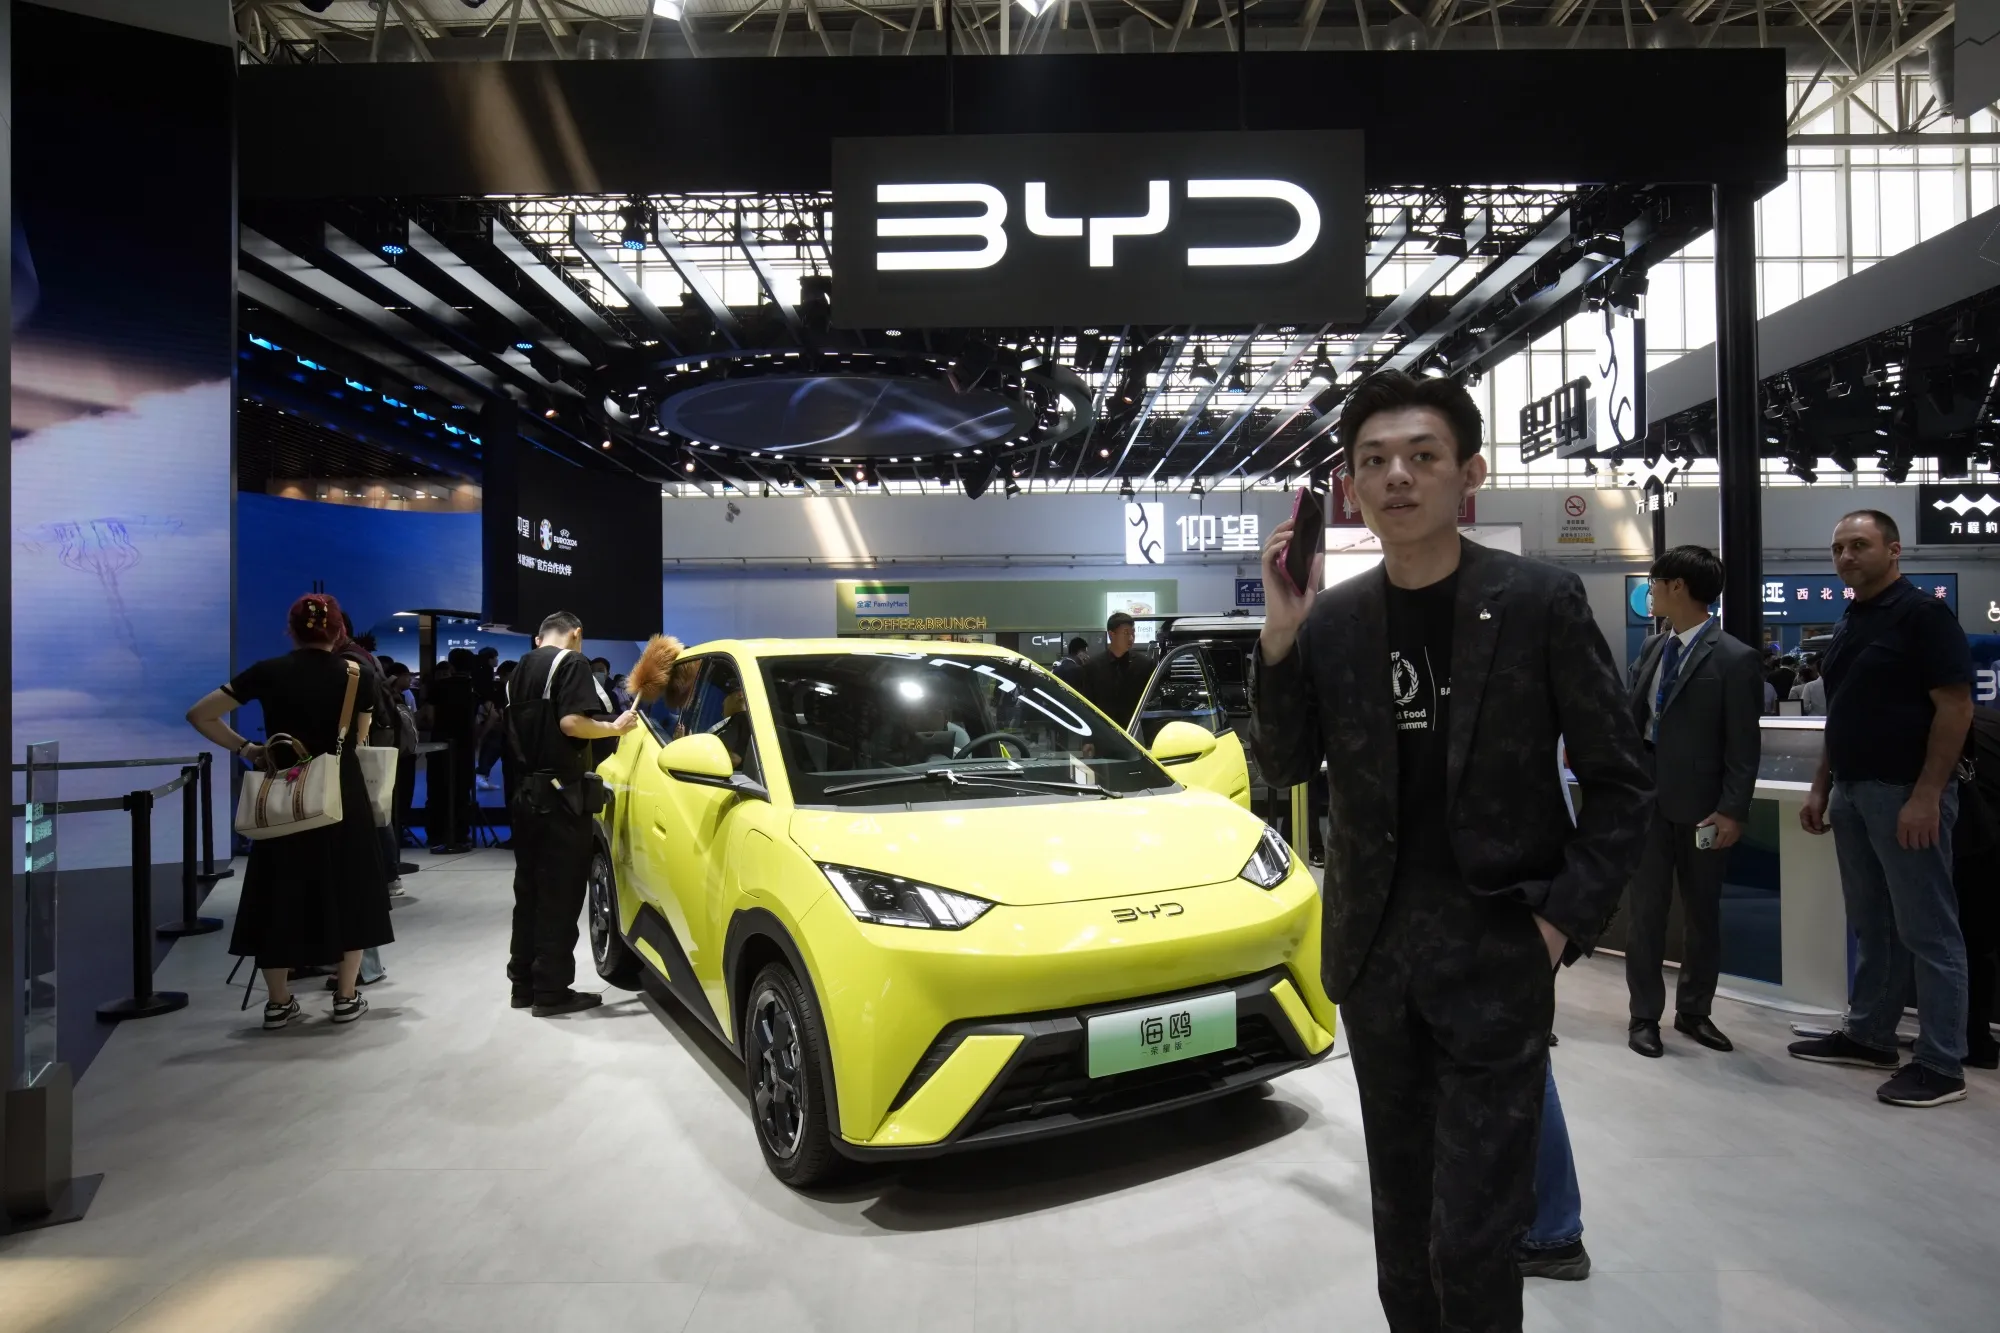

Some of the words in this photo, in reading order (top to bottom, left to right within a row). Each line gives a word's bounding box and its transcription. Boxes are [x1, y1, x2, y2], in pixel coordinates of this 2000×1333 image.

[877, 180, 1321, 271] BYD
[1176, 515, 1260, 551] 仰望
[1950, 521, 1998, 534] 方程豹
[873, 600, 908, 609] FamilyMart
[858, 616, 987, 631] COFFEE&BRUNCH
[1403, 708, 1427, 719] Food
[1111, 902, 1184, 923] BYD
[1140, 1011, 1192, 1047] 海鸥
